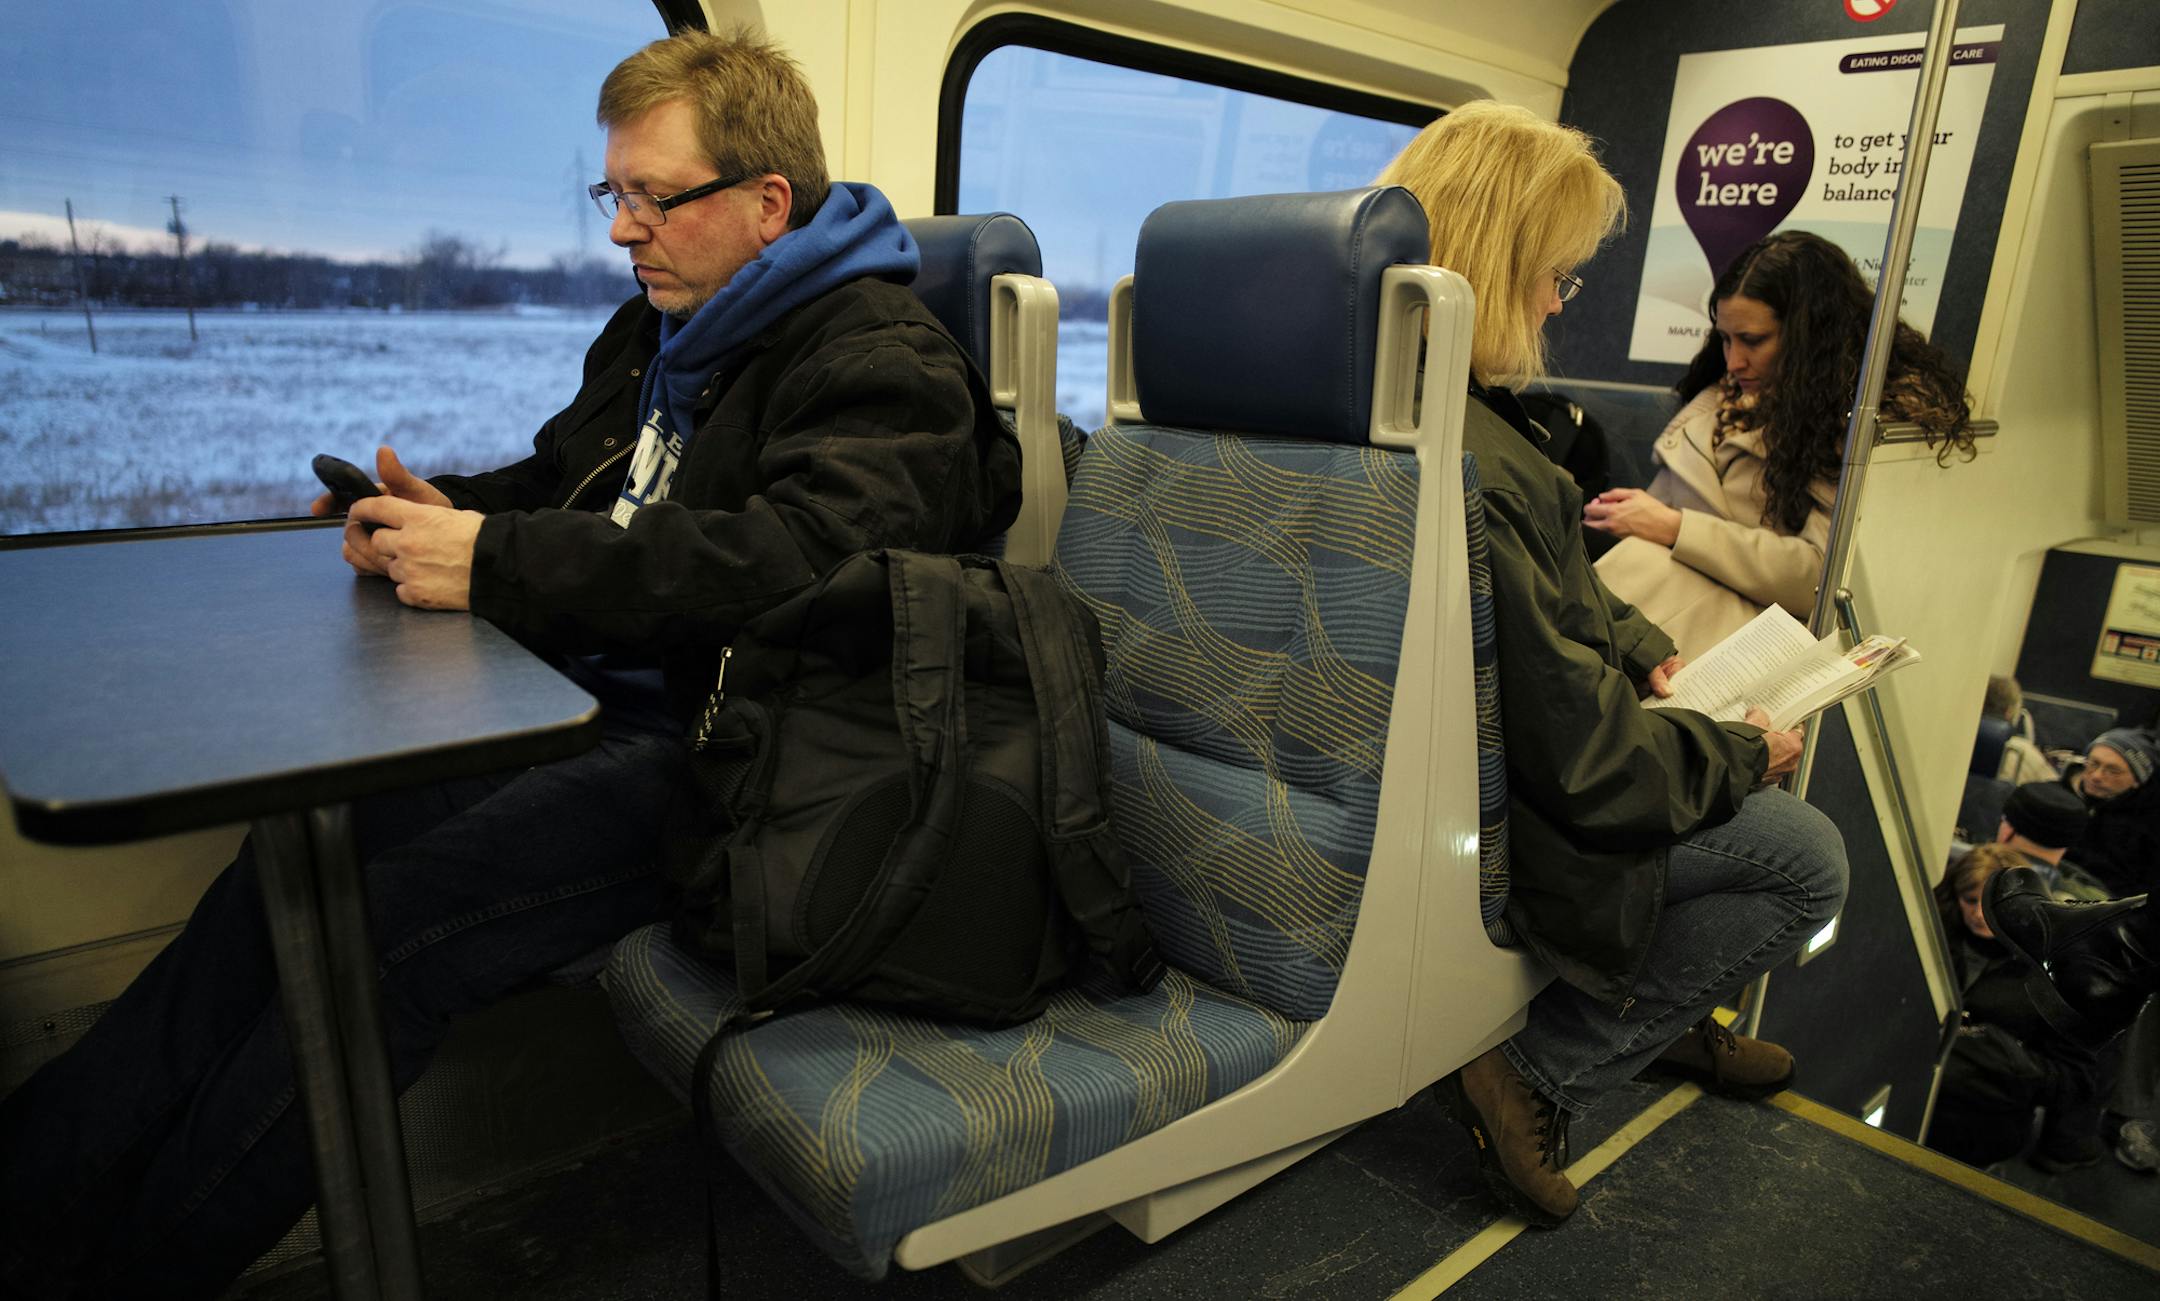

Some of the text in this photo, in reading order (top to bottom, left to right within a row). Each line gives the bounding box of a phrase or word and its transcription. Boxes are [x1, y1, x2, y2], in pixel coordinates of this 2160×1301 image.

[1850, 56, 1888, 69] EATING
[1953, 48, 1984, 60] CARE
[1697, 132, 1795, 167] we’re
[1834, 134, 1854, 148] to
[1860, 132, 1894, 152] get
[1828, 156, 1879, 179] body
[1696, 171, 1778, 206] here
